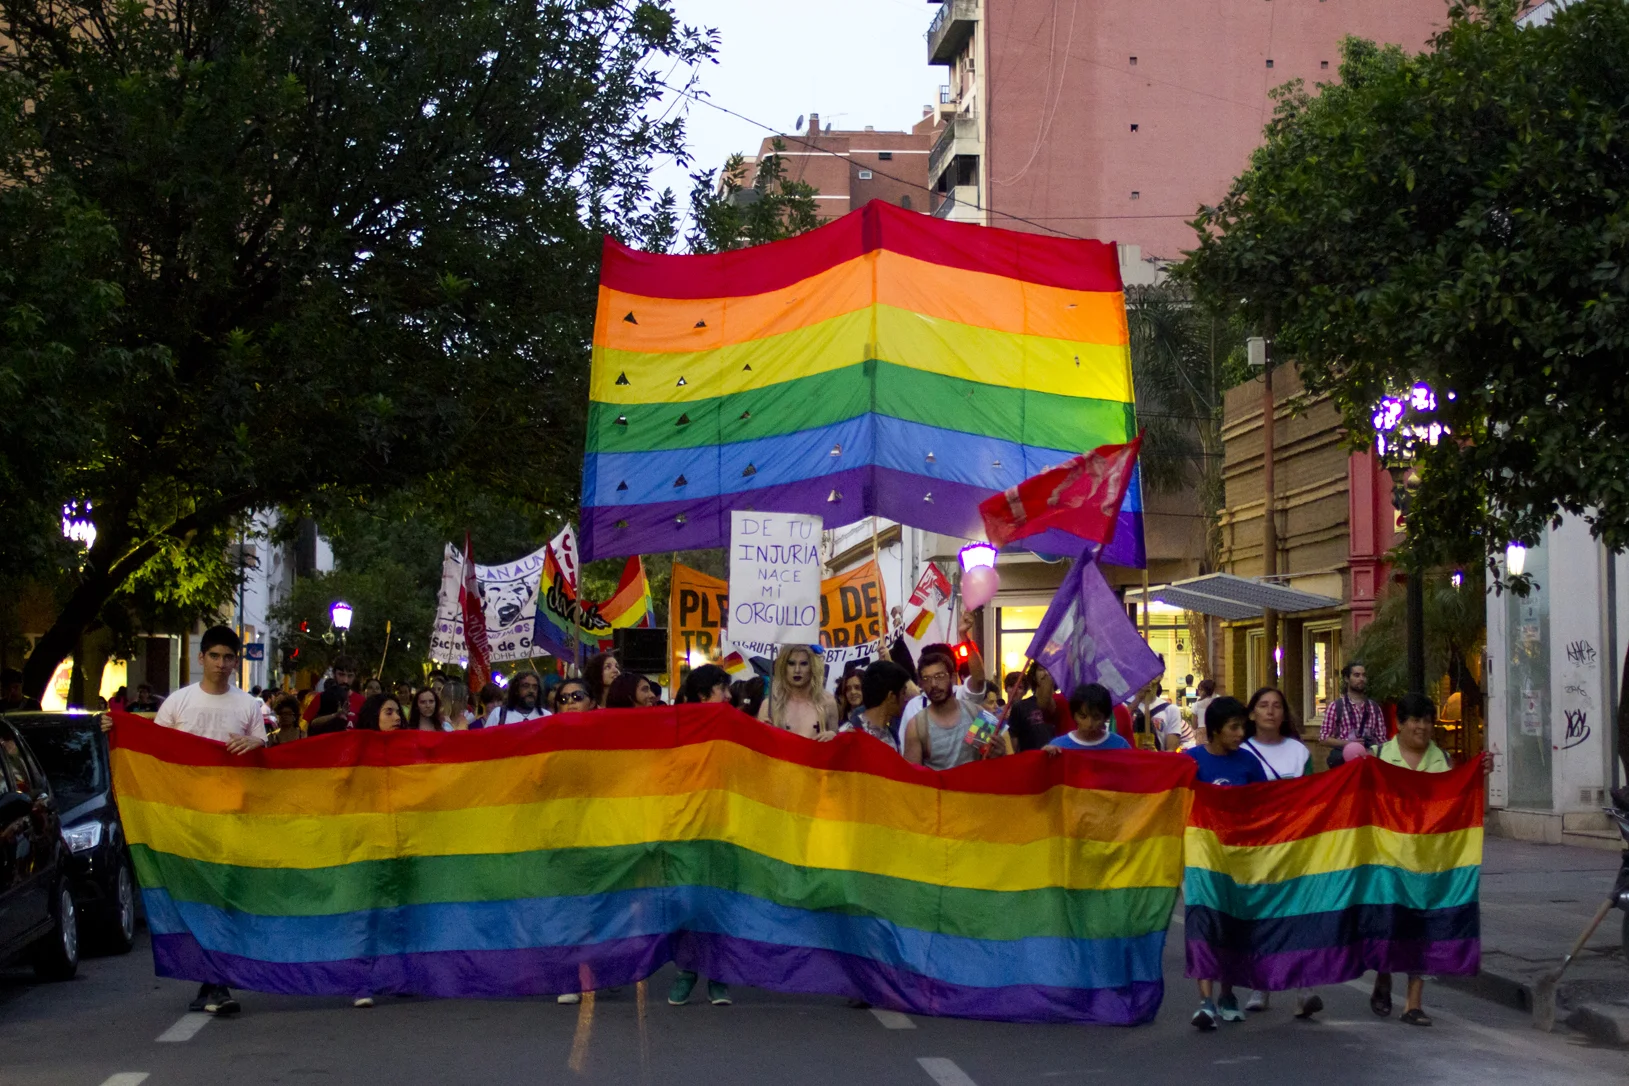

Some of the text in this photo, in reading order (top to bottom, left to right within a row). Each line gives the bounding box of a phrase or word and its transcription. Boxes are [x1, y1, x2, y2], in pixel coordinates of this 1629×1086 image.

[740, 518, 813, 540] DE TU
[757, 568, 802, 583] NACE
[839, 580, 879, 624] DE
[734, 601, 816, 627] ORGULLO
[497, 640, 516, 652] de
